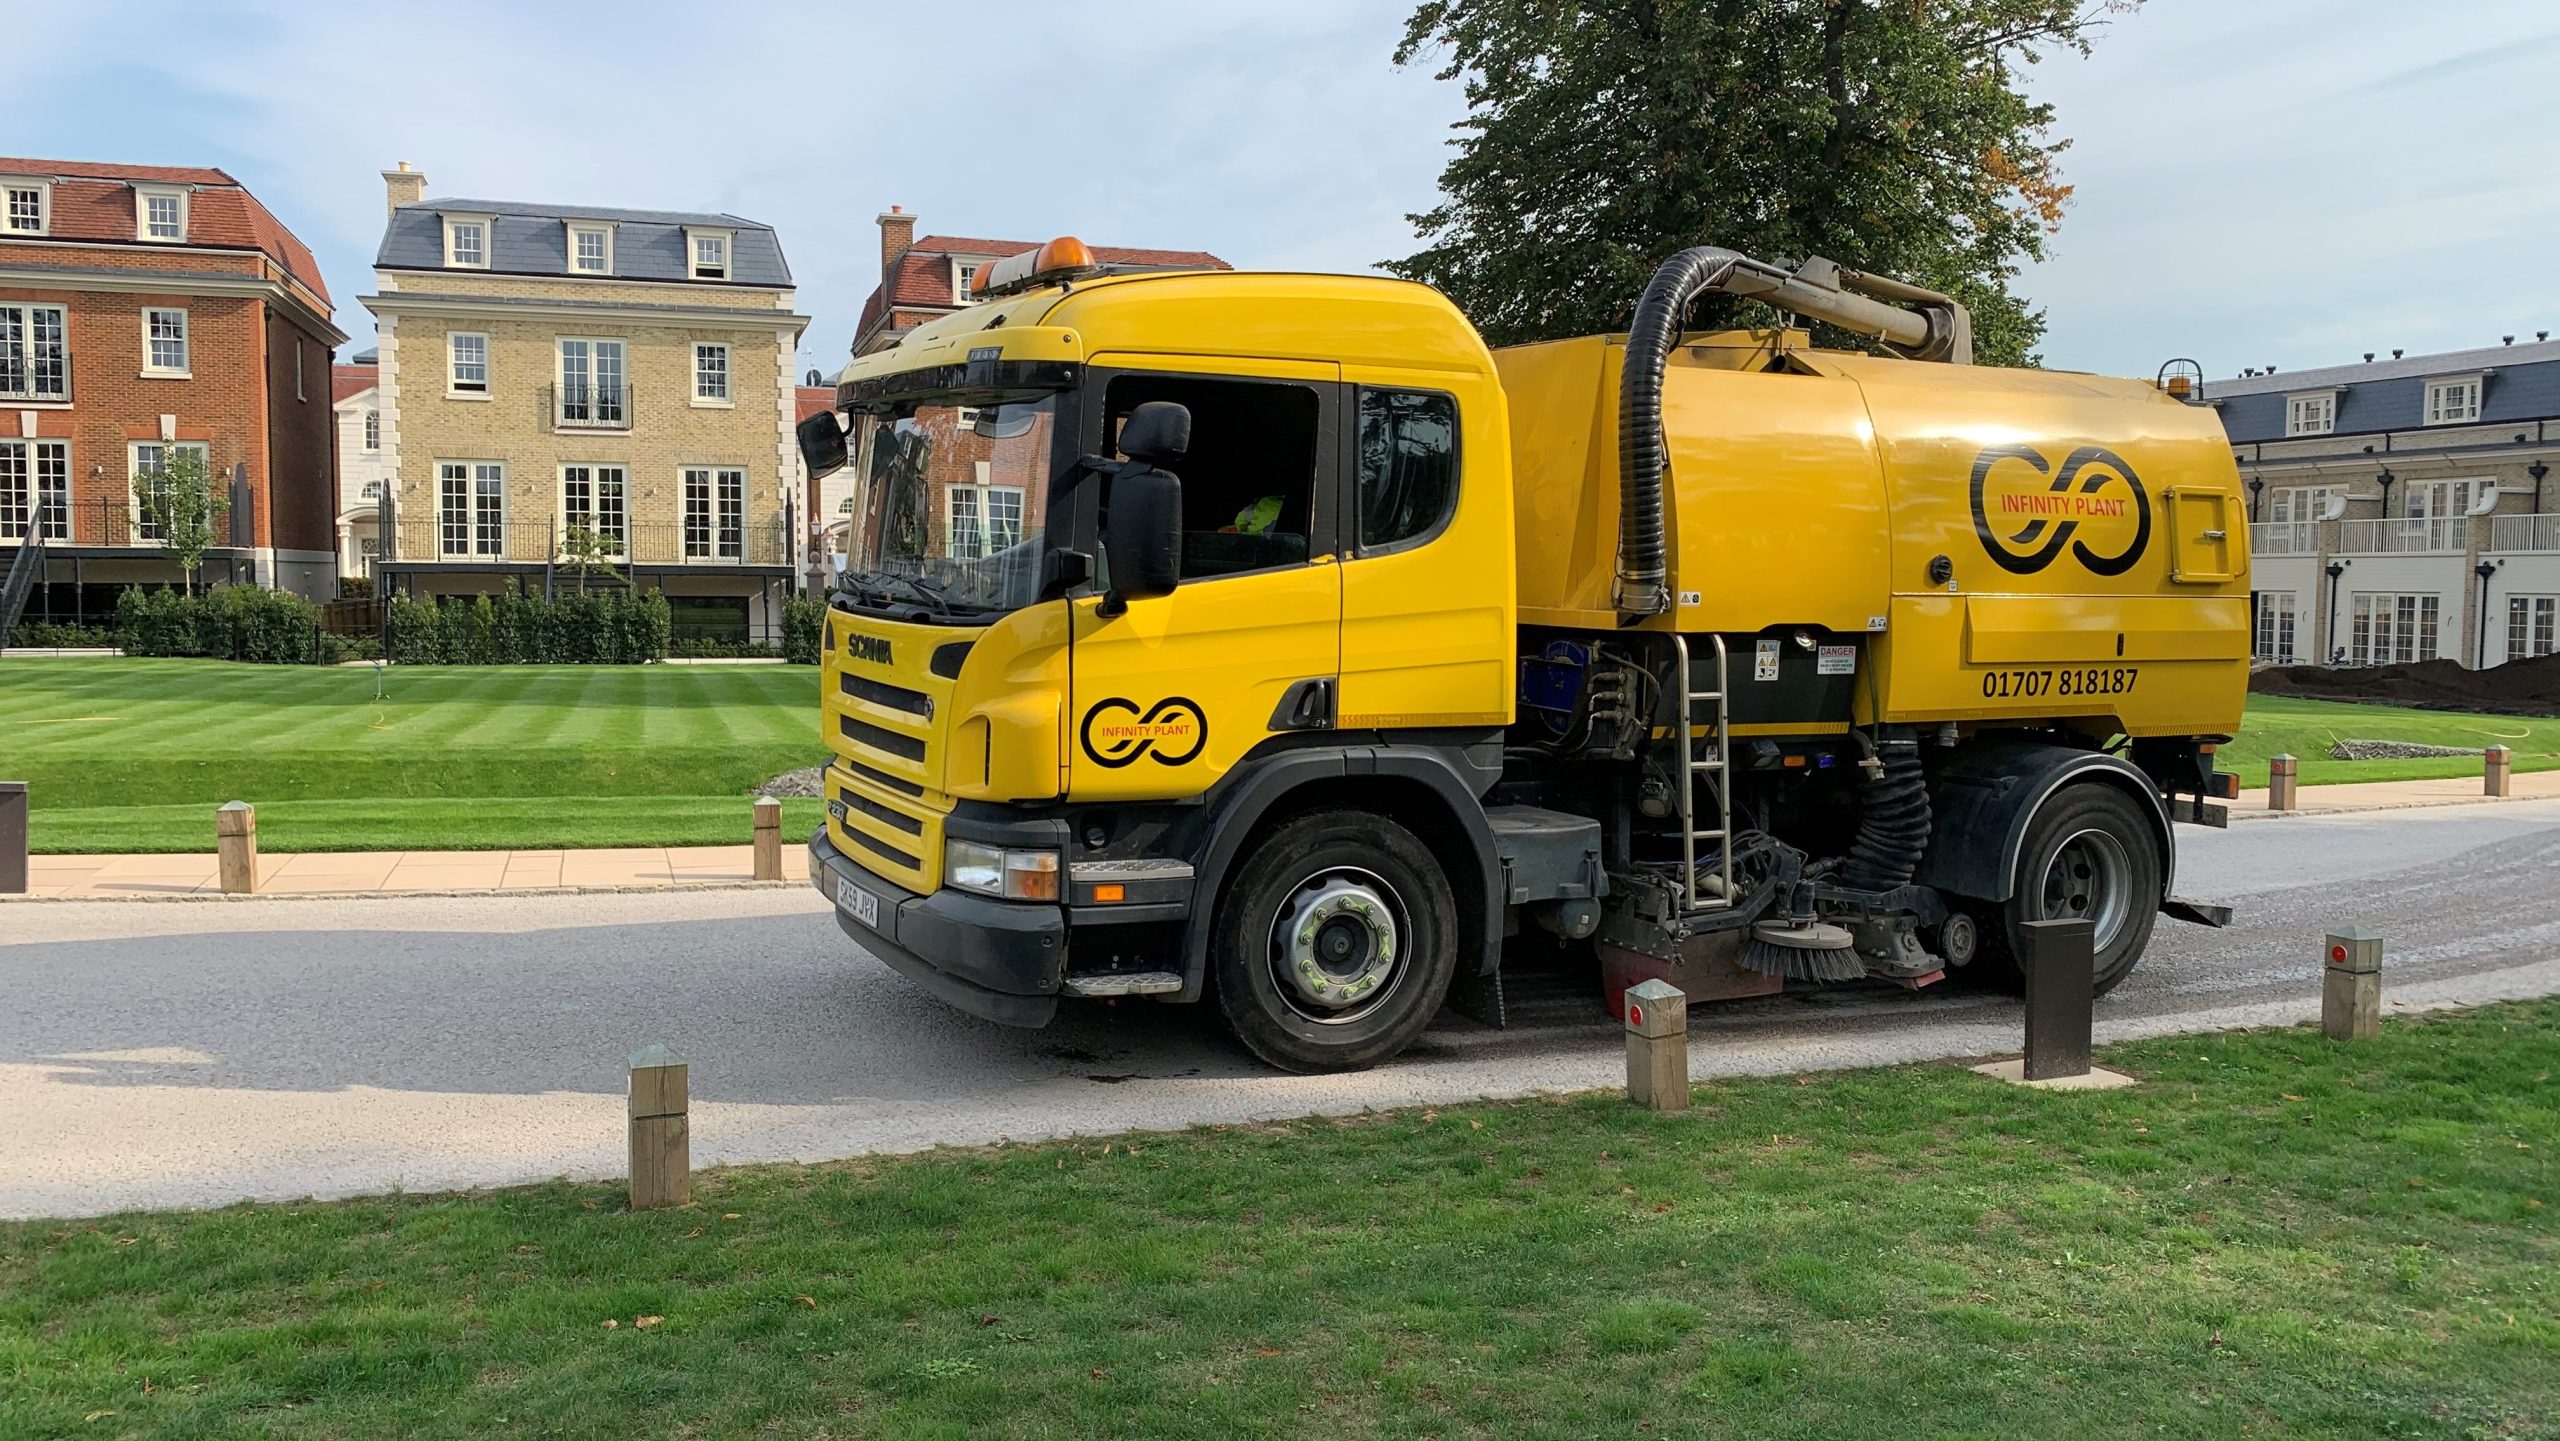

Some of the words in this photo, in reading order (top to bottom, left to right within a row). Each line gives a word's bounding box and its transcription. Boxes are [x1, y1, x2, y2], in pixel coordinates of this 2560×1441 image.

[2001, 494, 2070, 515] INFINITY
[2075, 497, 2125, 516] PLANT
[848, 633, 893, 666] SCANIA
[1821, 647, 1854, 656] DANGER
[1983, 671, 2052, 698] 01707
[2058, 669, 2138, 695] 818187
[1102, 726, 1151, 737] INFINITY
[1154, 725, 1190, 735] PLANT
